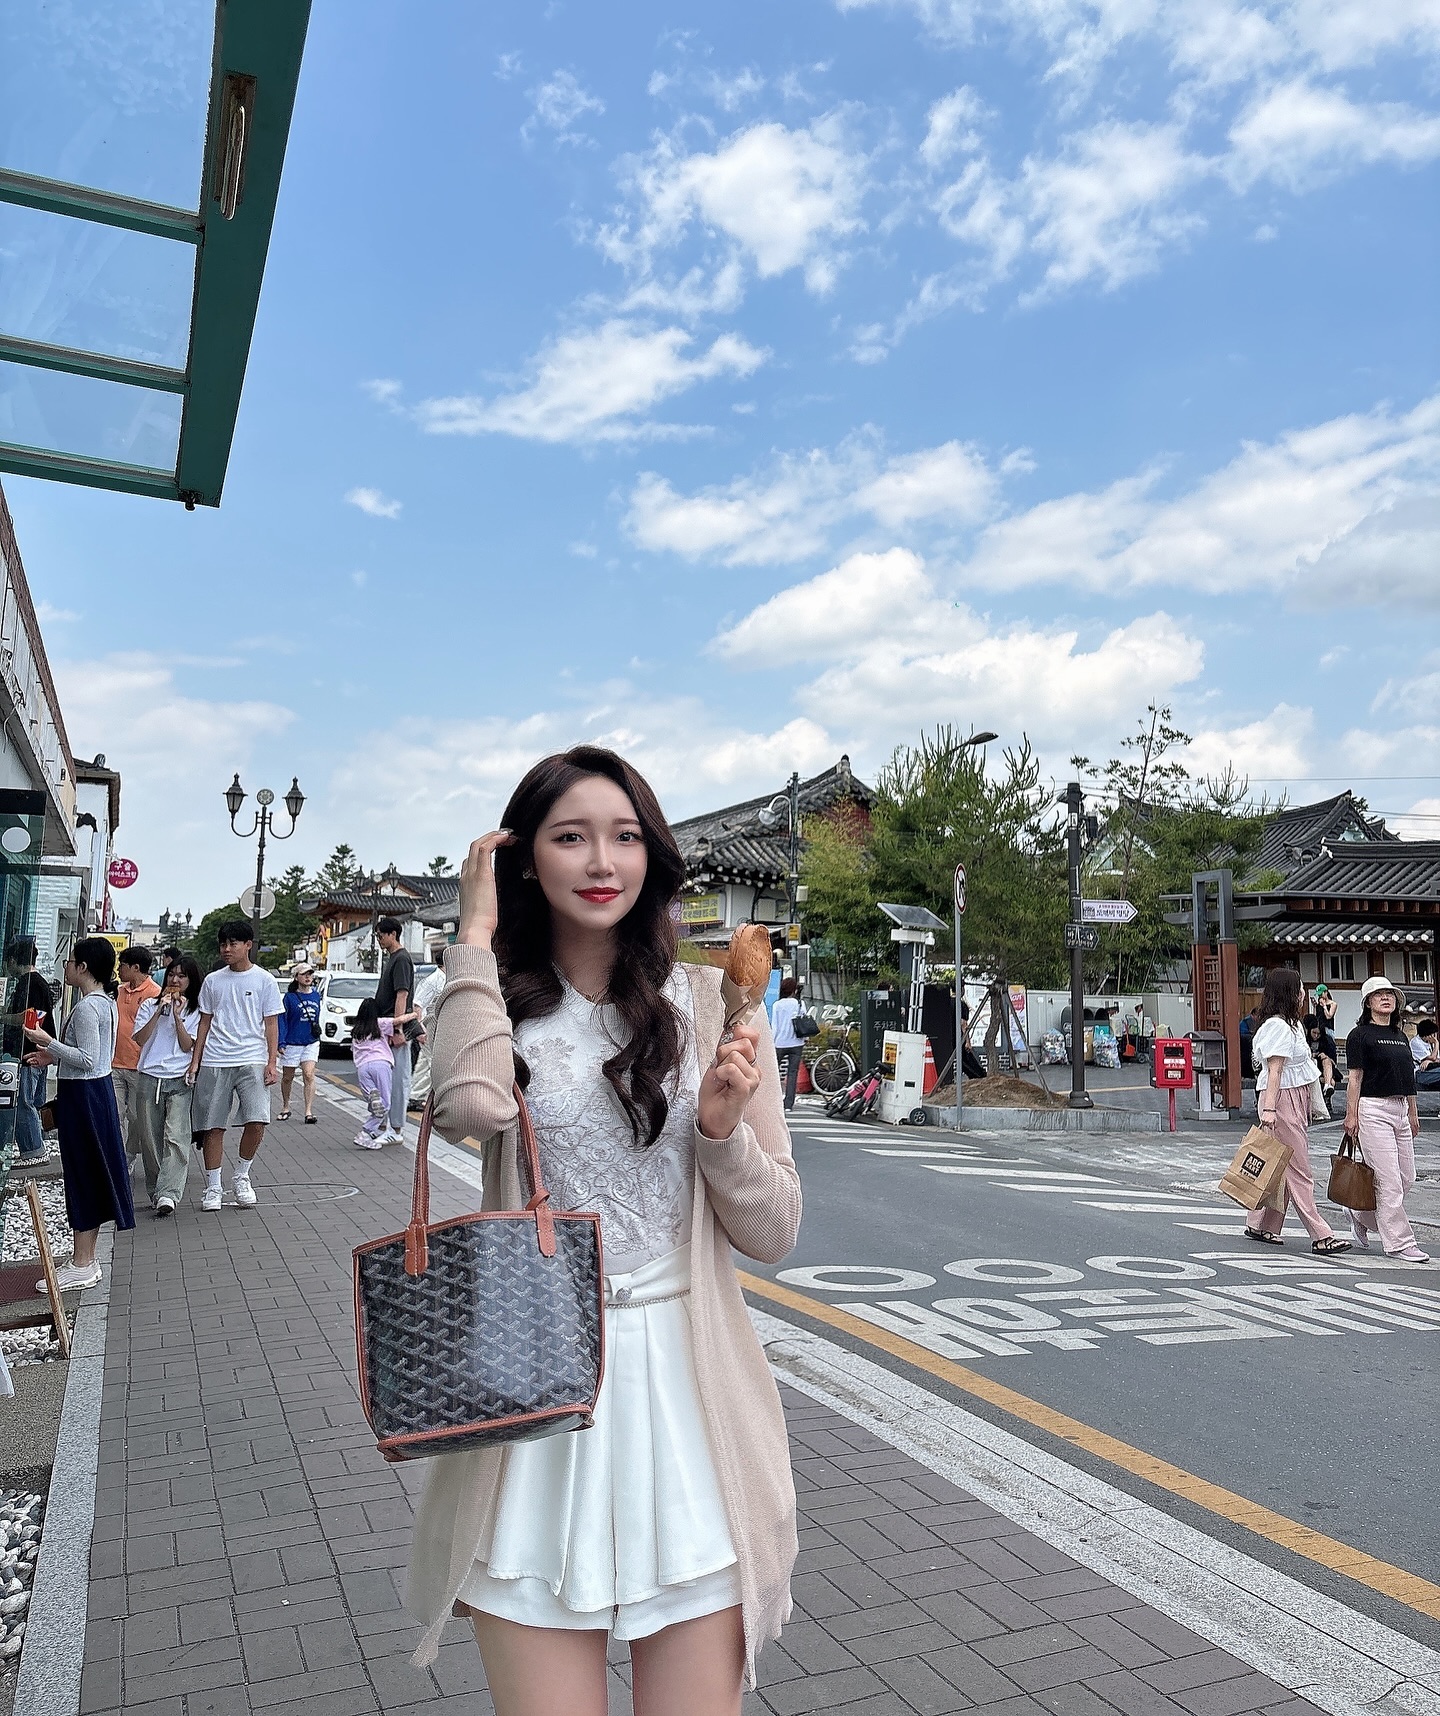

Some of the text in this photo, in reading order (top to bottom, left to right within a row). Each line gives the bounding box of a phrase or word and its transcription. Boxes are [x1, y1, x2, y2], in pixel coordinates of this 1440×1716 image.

[109, 870, 137, 879] 아이스크림
[873, 1020, 897, 1031] 주차장
[1247, 1156, 1262, 1168] ABC
[775, 1252, 1440, 1360] 일방통행
